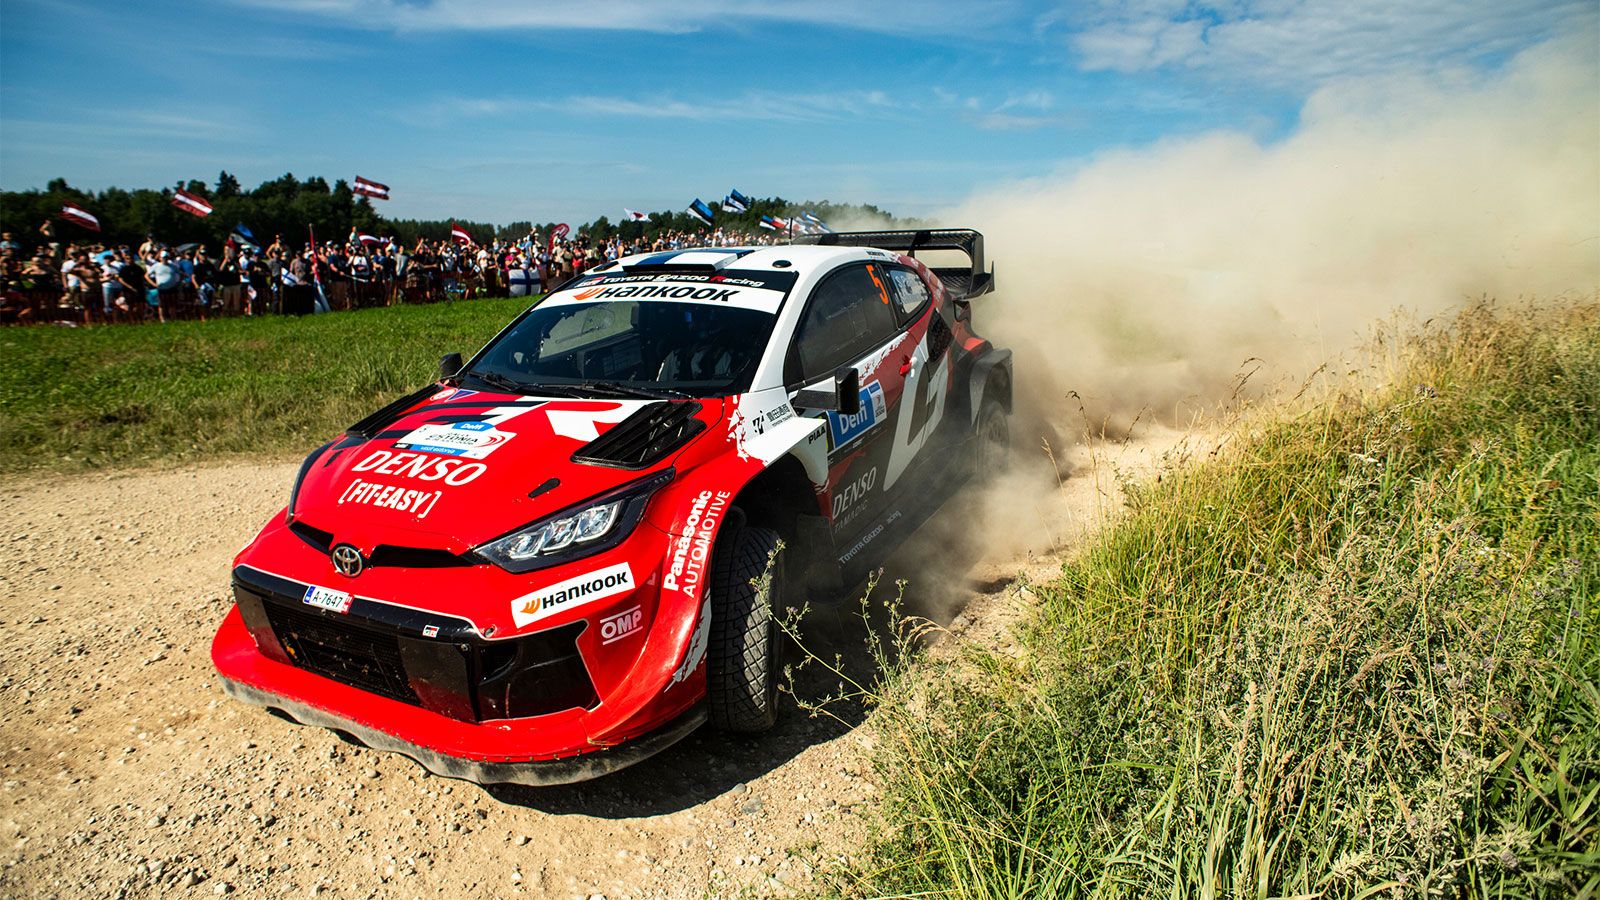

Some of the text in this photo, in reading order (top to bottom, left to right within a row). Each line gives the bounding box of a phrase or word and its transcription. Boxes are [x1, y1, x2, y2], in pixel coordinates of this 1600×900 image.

[603, 275, 653, 284] TOYOTA
[653, 275, 710, 283] GAZOO
[711, 275, 764, 287] Racing
[866, 264, 889, 304] 5
[808, 425, 826, 445] PIAA
[351, 450, 488, 486] DENSO
[832, 466, 877, 521] DENSO
[663, 489, 713, 591] Panasonic
[683, 489, 731, 598] AUTOMOTIVE
[838, 541, 865, 564] TOYOTA
[312, 591, 343, 608] A-7647
[600, 610, 643, 639] OMP
